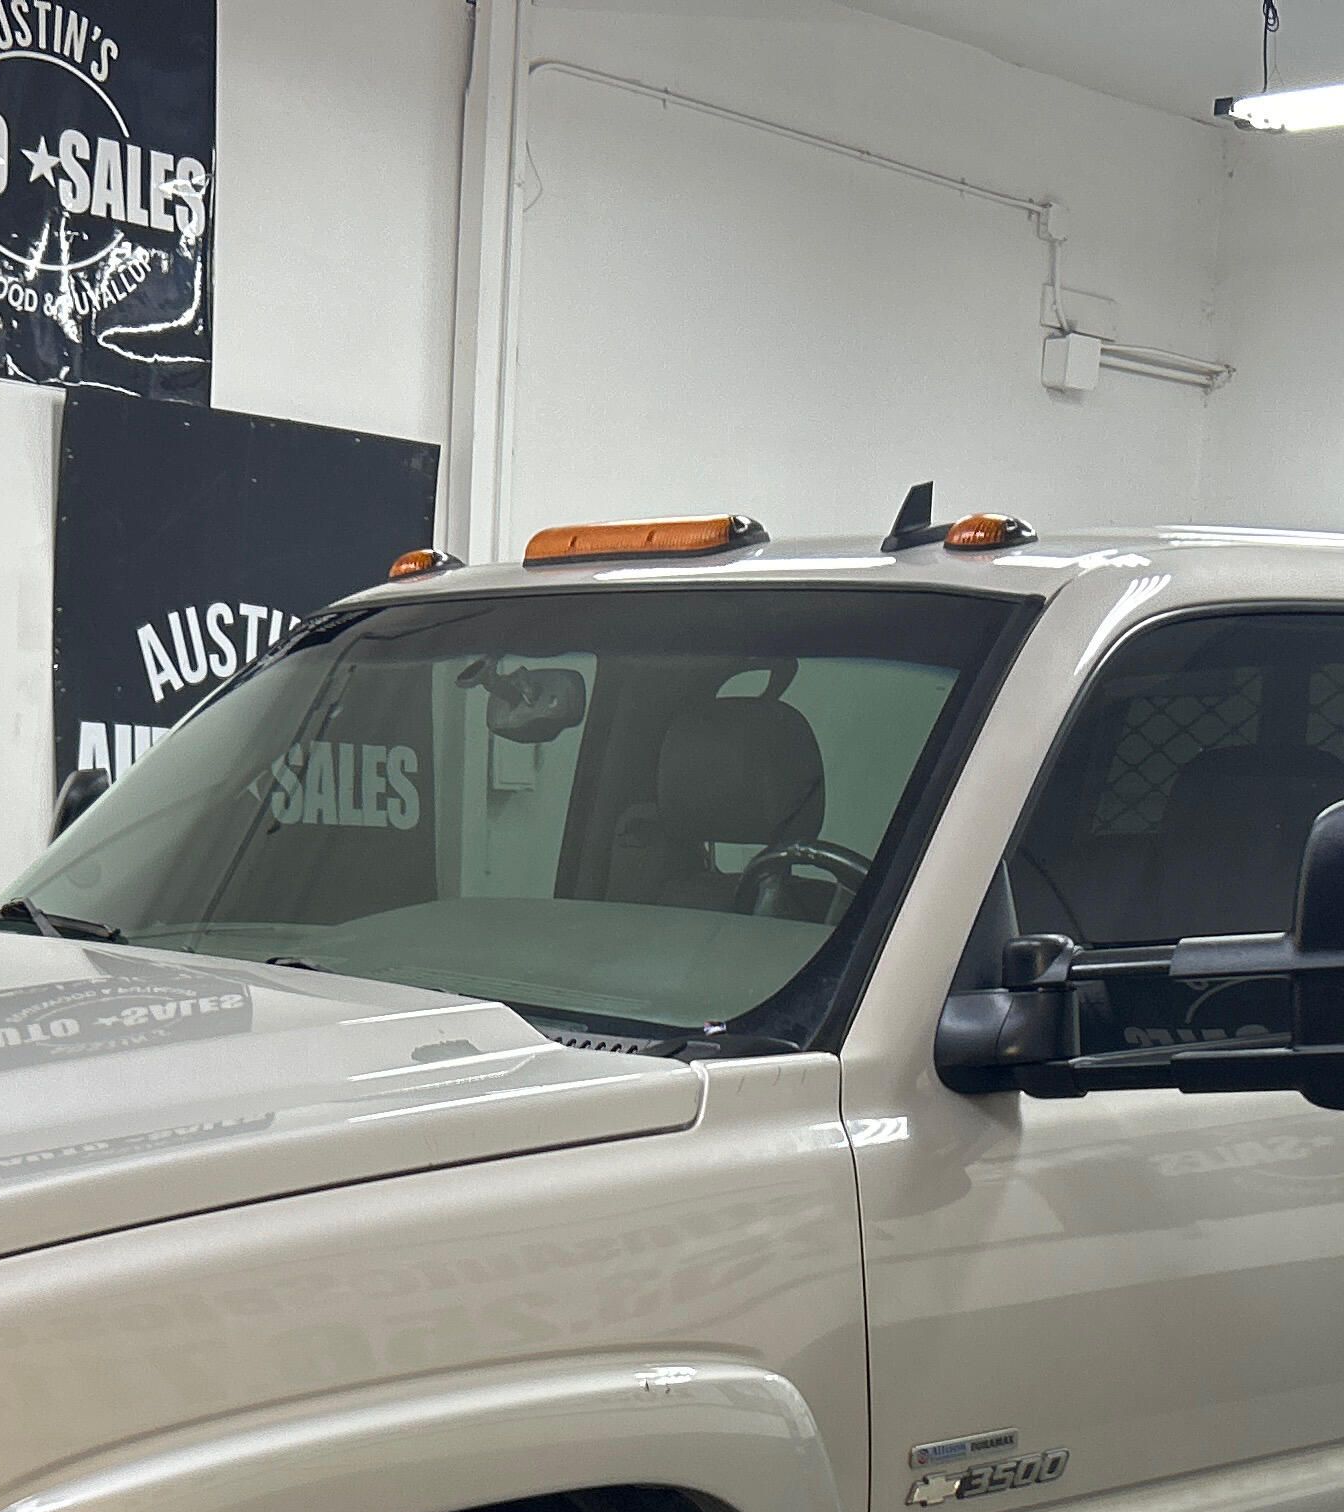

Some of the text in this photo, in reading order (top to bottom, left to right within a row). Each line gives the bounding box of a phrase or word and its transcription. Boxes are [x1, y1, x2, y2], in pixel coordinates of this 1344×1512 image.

[58, 128, 207, 238] SALES
[59, 245, 154, 316] UYALLUP
[137, 602, 302, 703] AUSTI
[271, 740, 420, 830] SALES
[958, 1448, 1070, 1499] 3500
